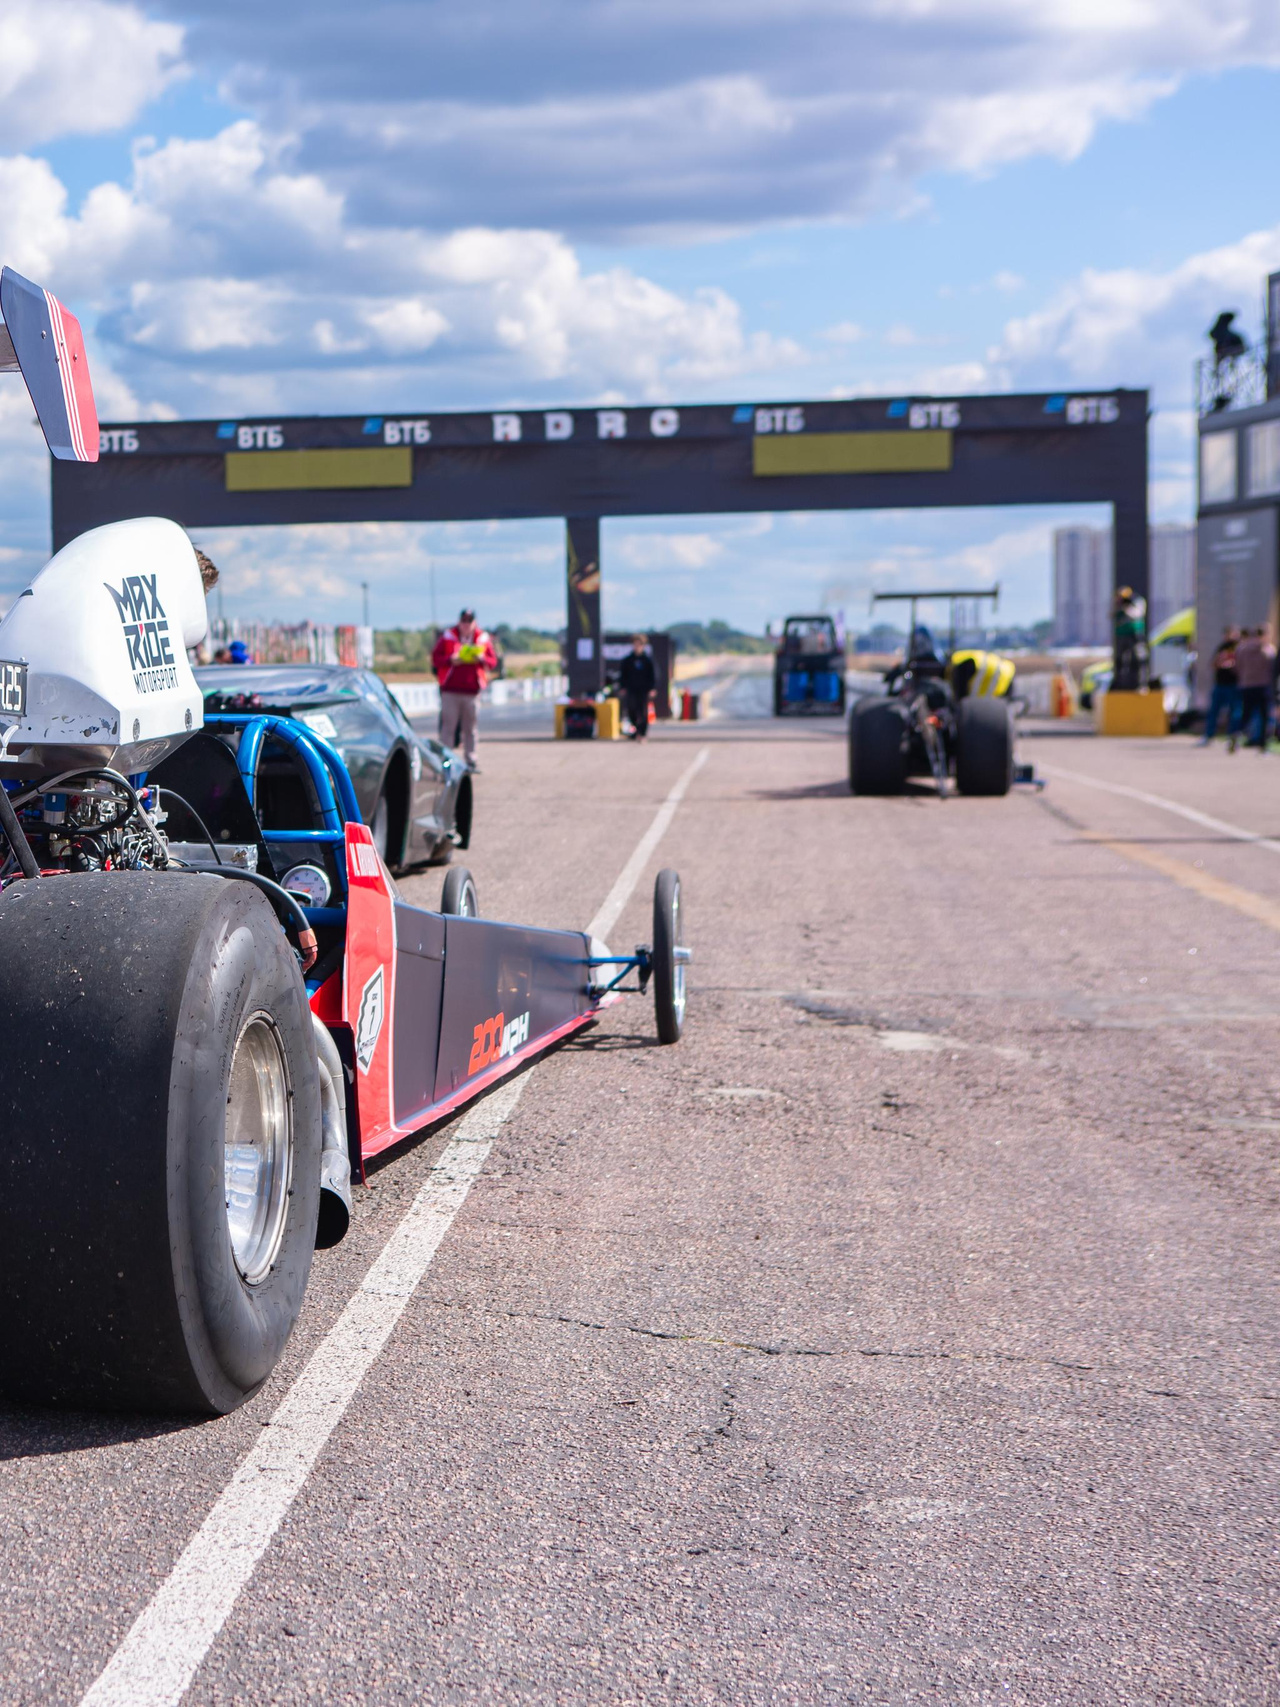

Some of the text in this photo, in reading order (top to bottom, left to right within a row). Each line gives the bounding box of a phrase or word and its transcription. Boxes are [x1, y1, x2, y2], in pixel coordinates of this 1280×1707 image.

[755, 407, 805, 433] ВТБ
[909, 402, 960, 429] ВТБ
[1066, 397, 1120, 424] ВТБ
[237, 425, 284, 448] ВТБ
[383, 421, 431, 444] ВТБ
[103, 574, 166, 624] MAX
[123, 620, 175, 670] RIDE
[133, 667, 179, 694] MOTORSPORT
